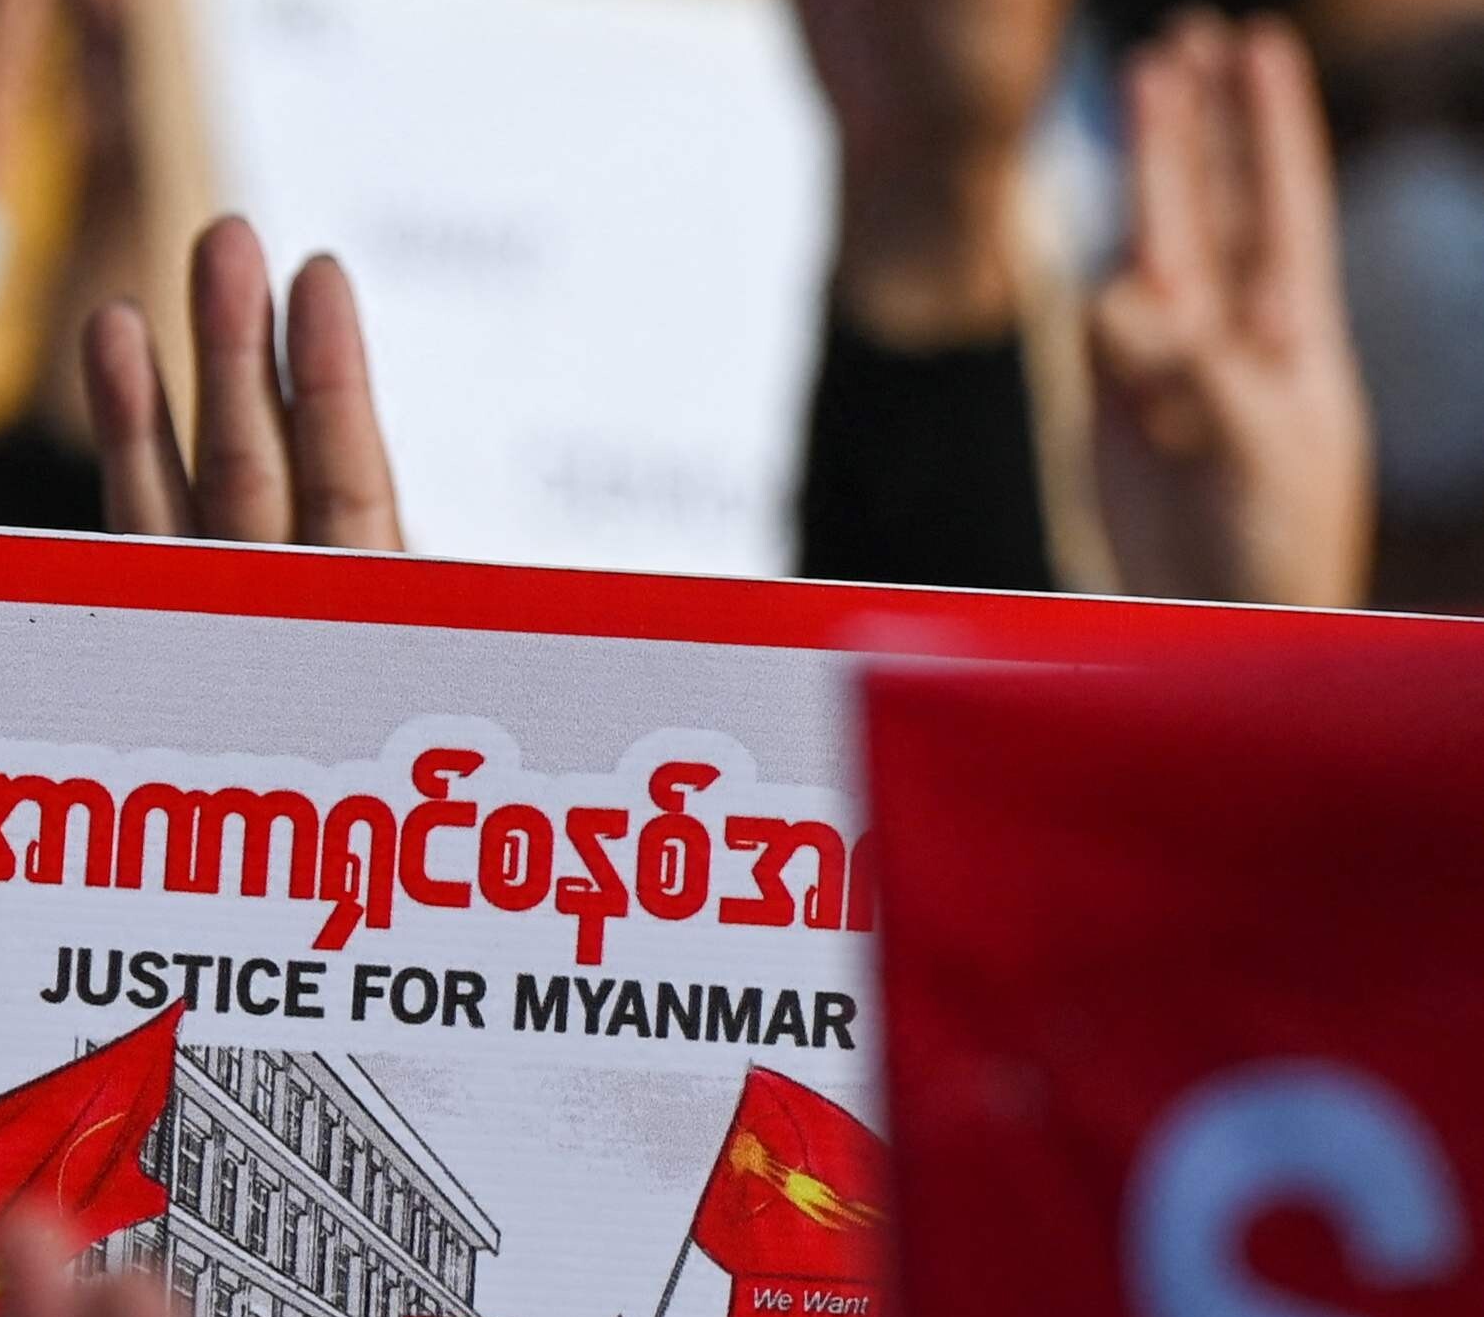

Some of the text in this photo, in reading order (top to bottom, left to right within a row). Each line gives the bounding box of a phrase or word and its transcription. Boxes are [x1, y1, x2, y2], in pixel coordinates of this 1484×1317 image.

[40, 946, 858, 1051] JUSTICE FOR MYANMAR
[753, 1287, 870, 1316] We Want
